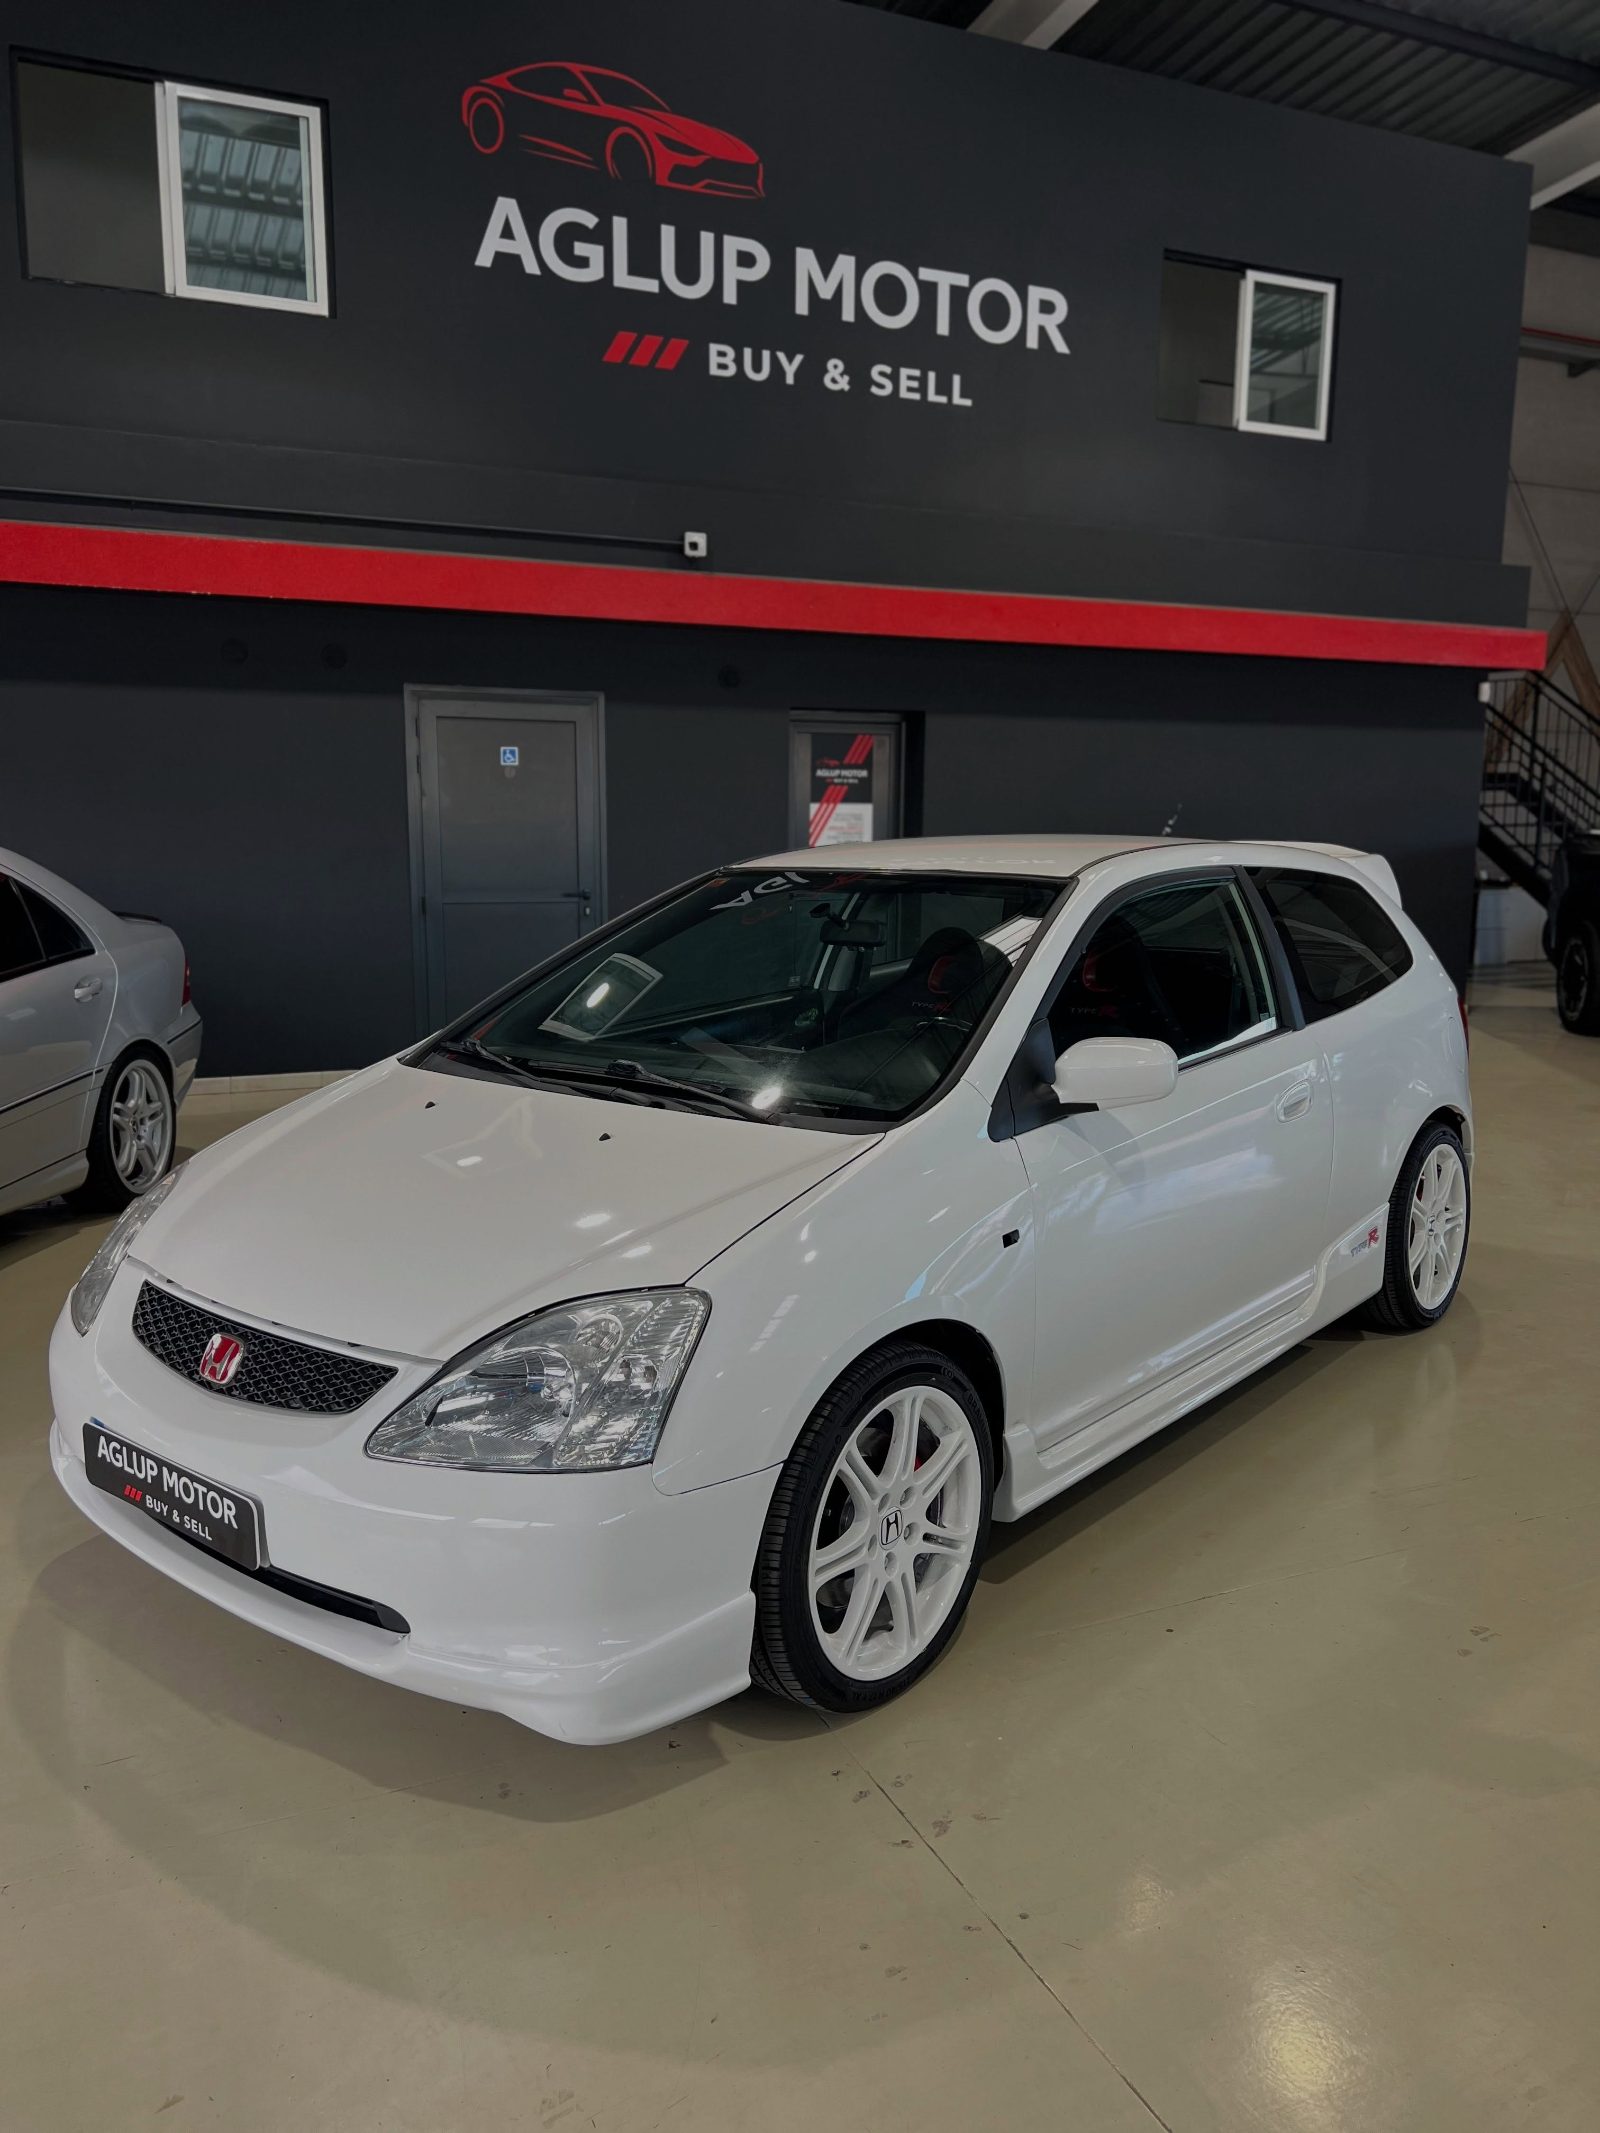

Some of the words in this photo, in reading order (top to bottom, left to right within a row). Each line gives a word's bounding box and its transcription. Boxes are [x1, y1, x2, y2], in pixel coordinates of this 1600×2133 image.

[474, 196, 770, 305] AGLUP
[795, 246, 1071, 354] MOTOR
[708, 342, 804, 385] BUY
[823, 358, 851, 392] &
[870, 363, 973, 407] SELL
[97, 1435, 158, 1483] AGLUP
[162, 1466, 239, 1529] MOTOR
[145, 1494, 169, 1517] BUY
[172, 1510, 180, 1523] &
[183, 1515, 213, 1541] SELL
